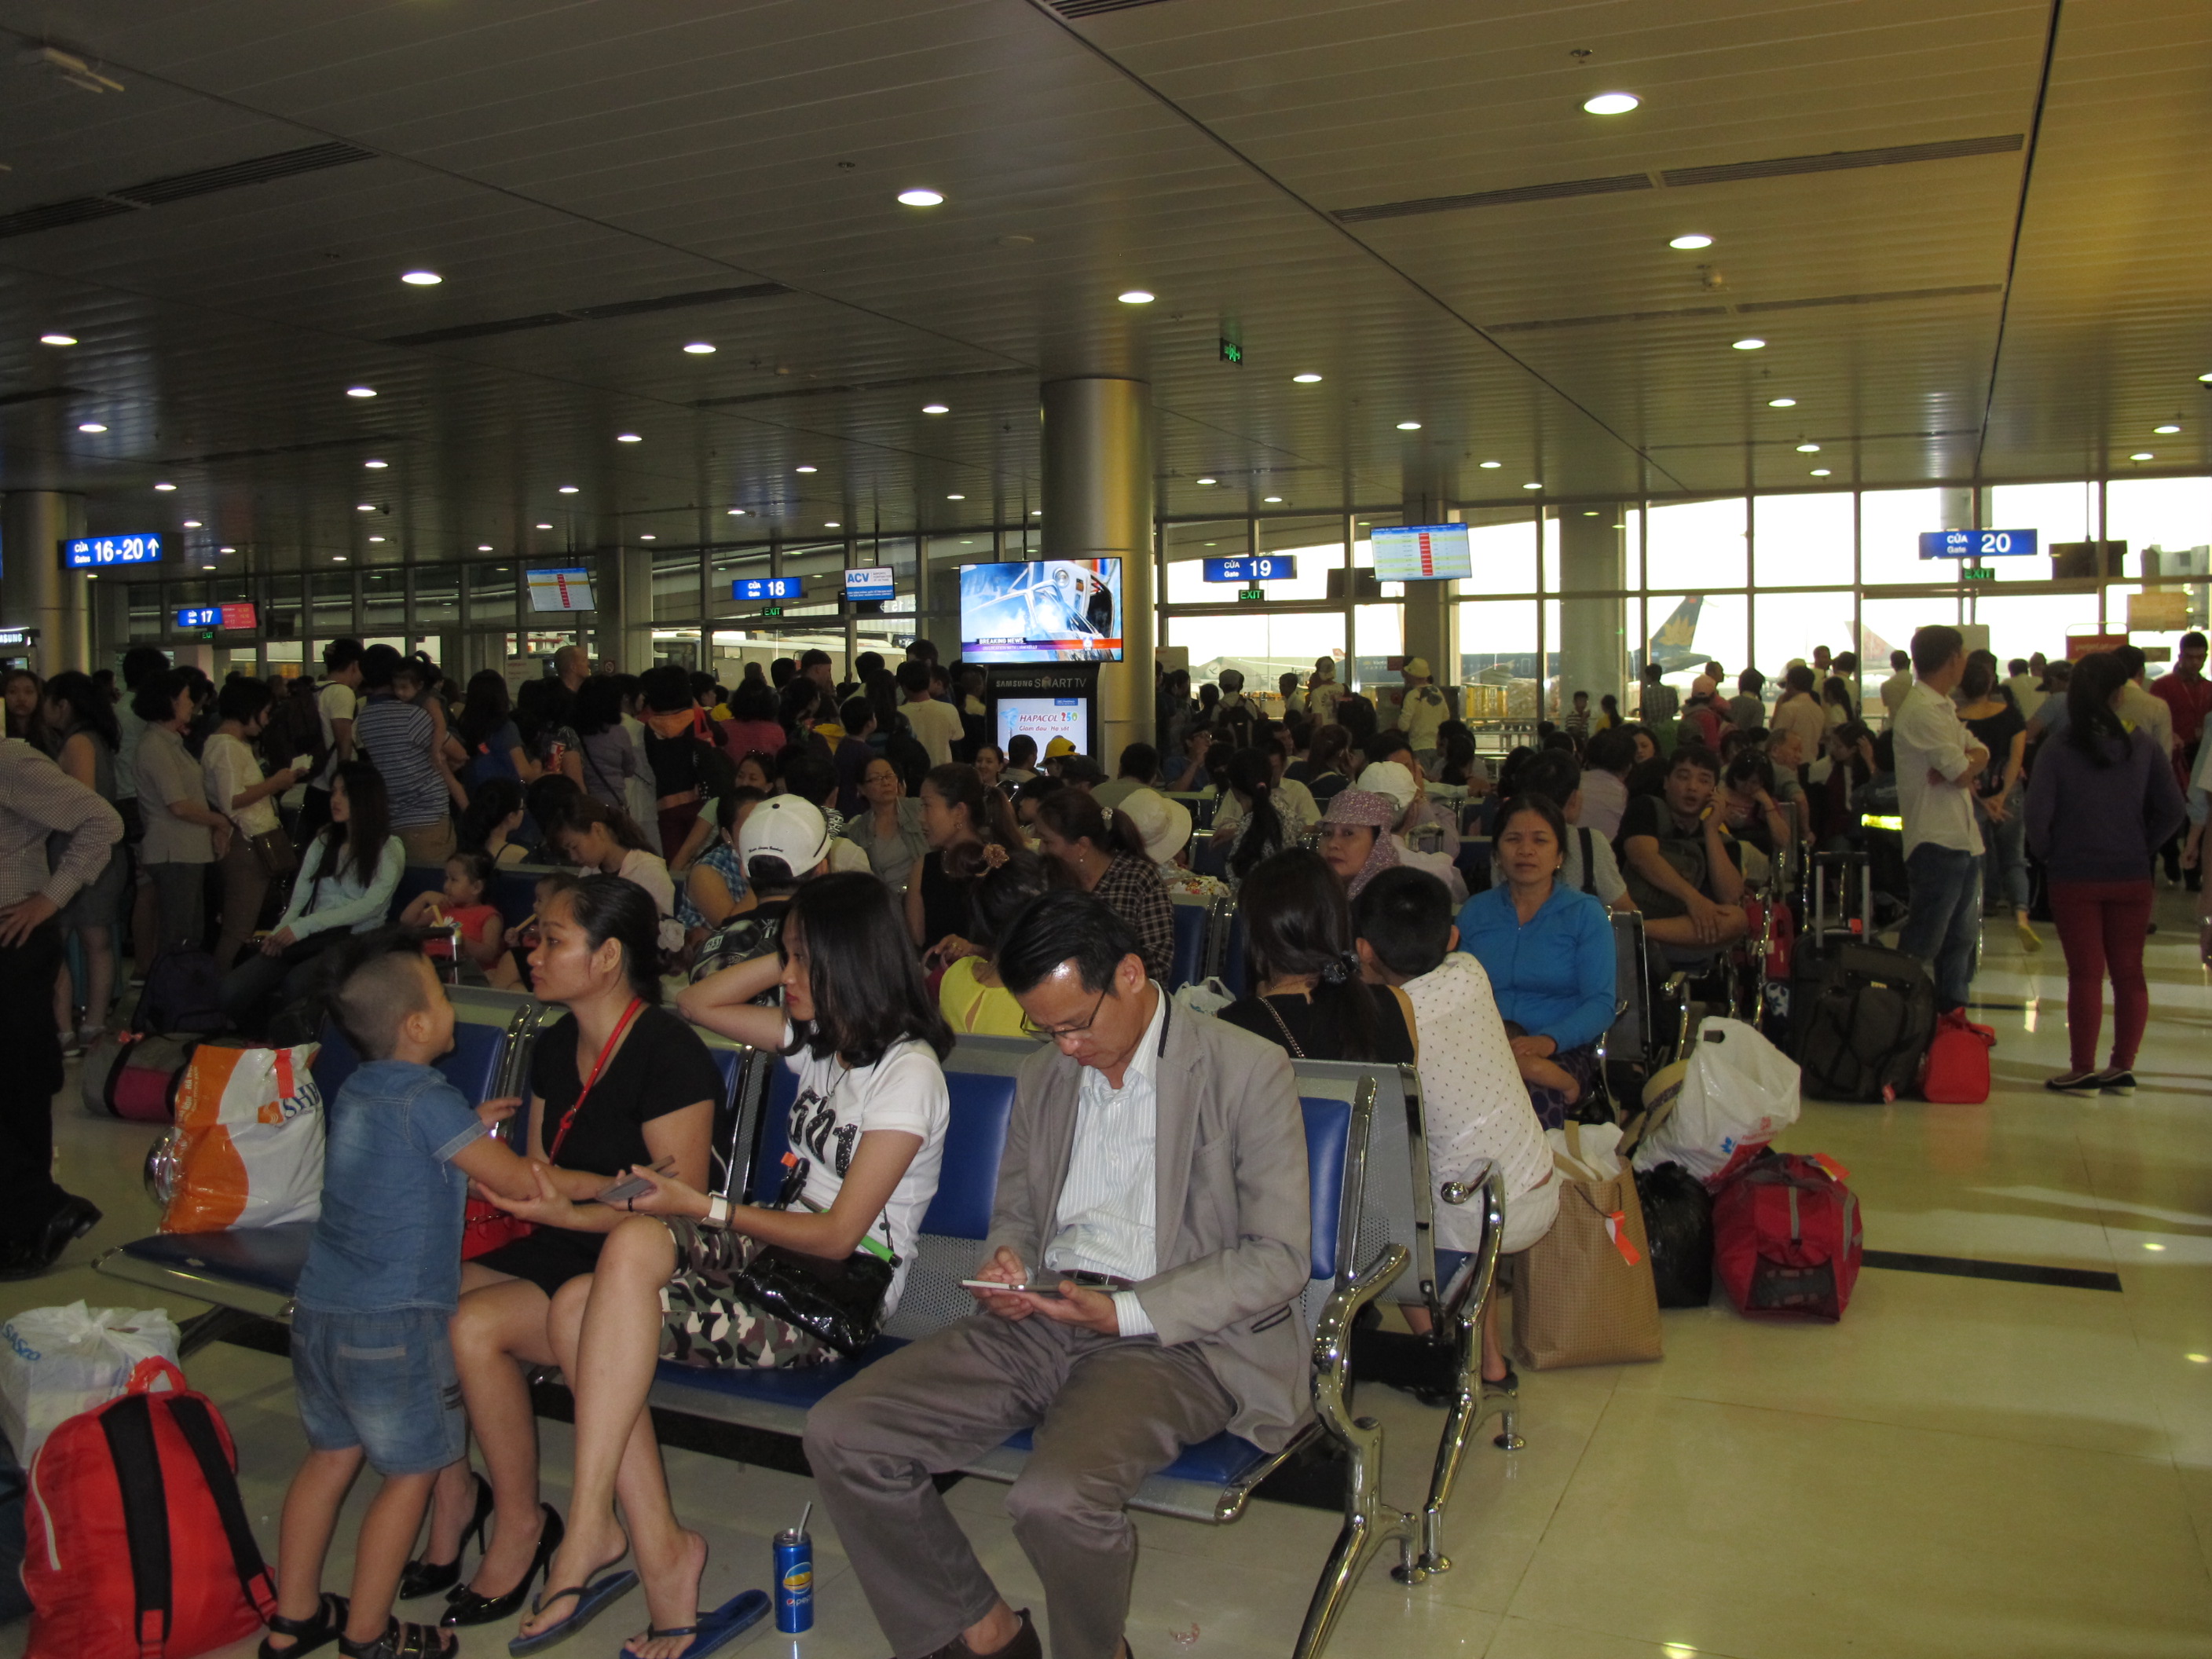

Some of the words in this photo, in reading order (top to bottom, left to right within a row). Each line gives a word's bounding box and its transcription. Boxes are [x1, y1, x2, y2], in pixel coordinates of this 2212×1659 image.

[1980, 533, 2011, 553] 20
[1250, 560, 1272, 577] 19
[848, 573, 870, 583] ACV
[1965, 569, 1990, 580] EXIT
[767, 580, 786, 596] 18
[1240, 591, 1262, 599] EXIT
[201, 610, 214, 623] 17
[764, 607, 781, 616] EXIT
[1075, 678, 1086, 687] TV
[1061, 712, 1078, 722] 250
